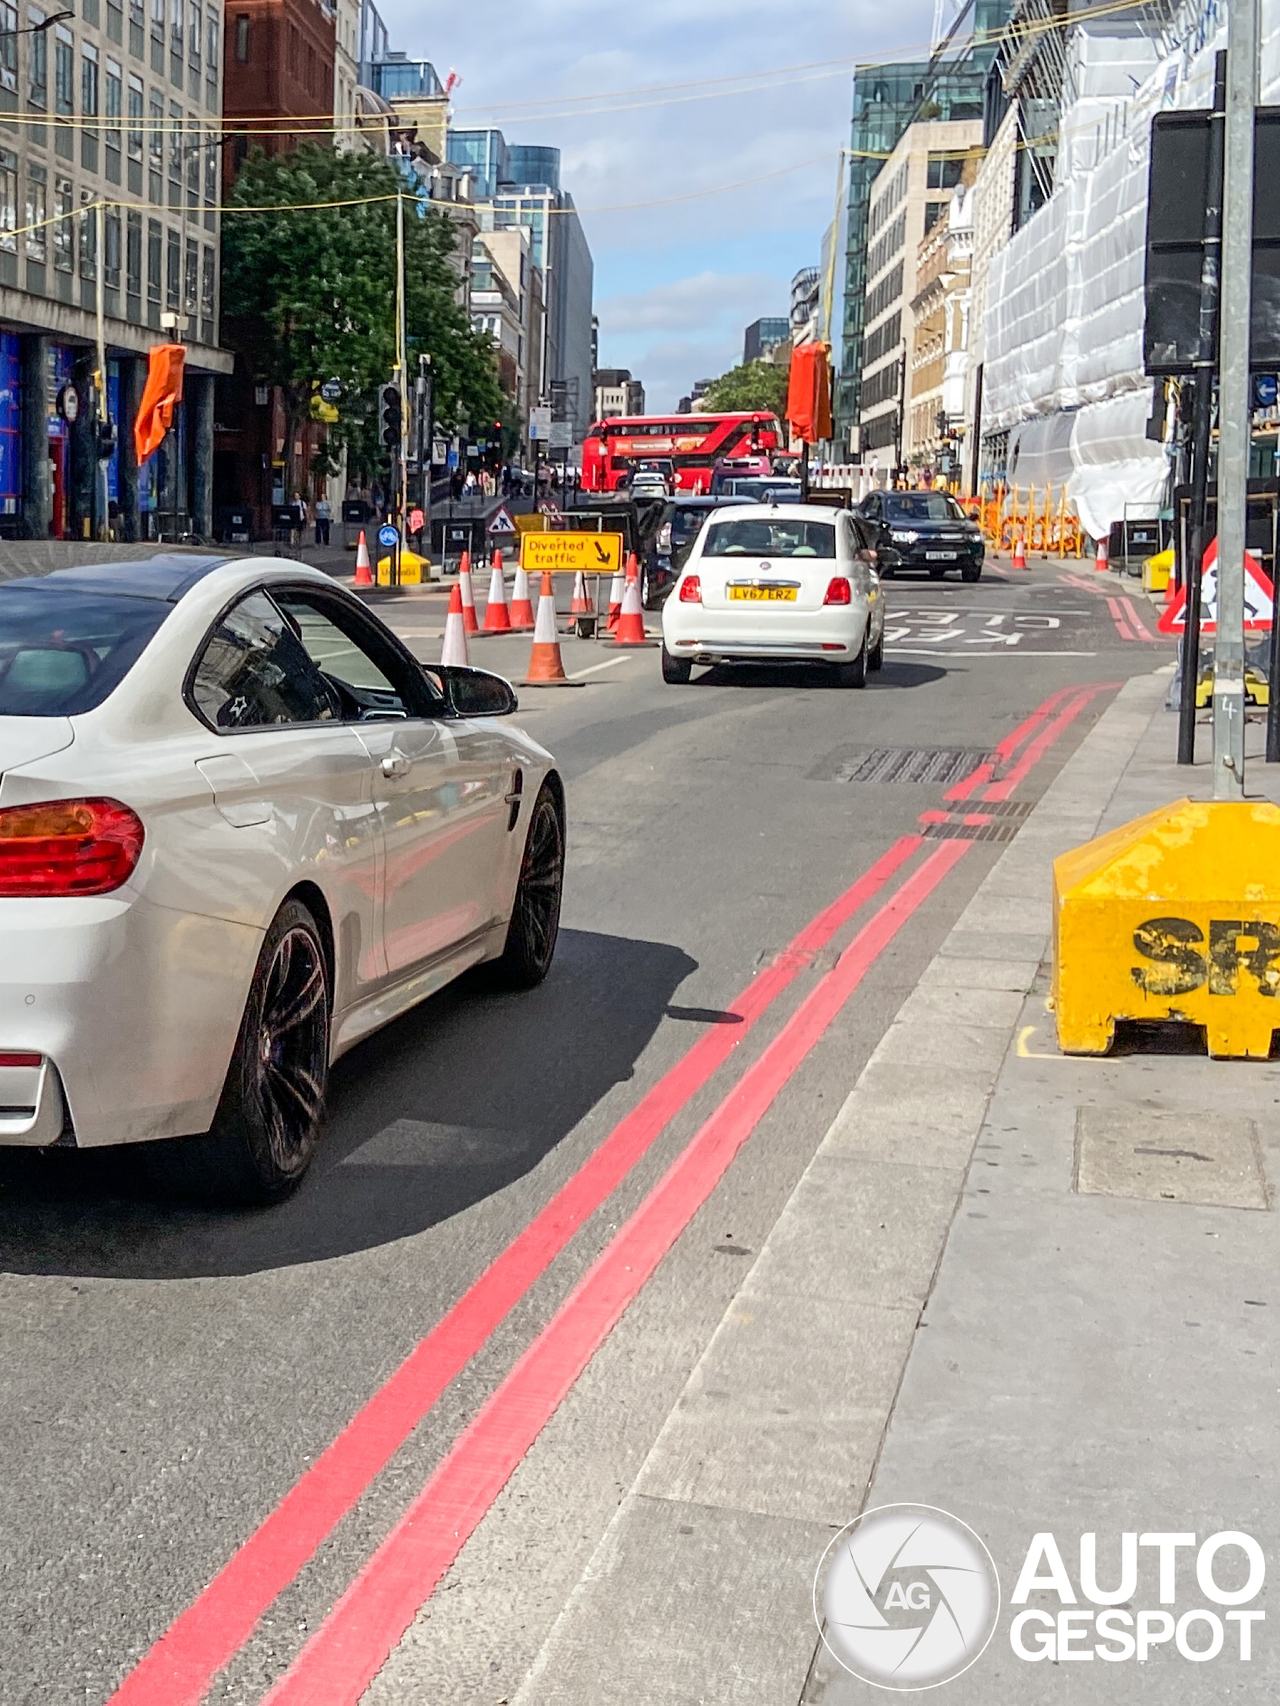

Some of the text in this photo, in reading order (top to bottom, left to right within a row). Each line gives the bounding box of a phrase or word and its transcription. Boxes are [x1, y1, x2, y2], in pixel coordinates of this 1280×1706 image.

[529, 541, 584, 551] Diverted
[535, 553, 577, 564] traffic
[733, 589, 792, 600] LV67 ERZ
